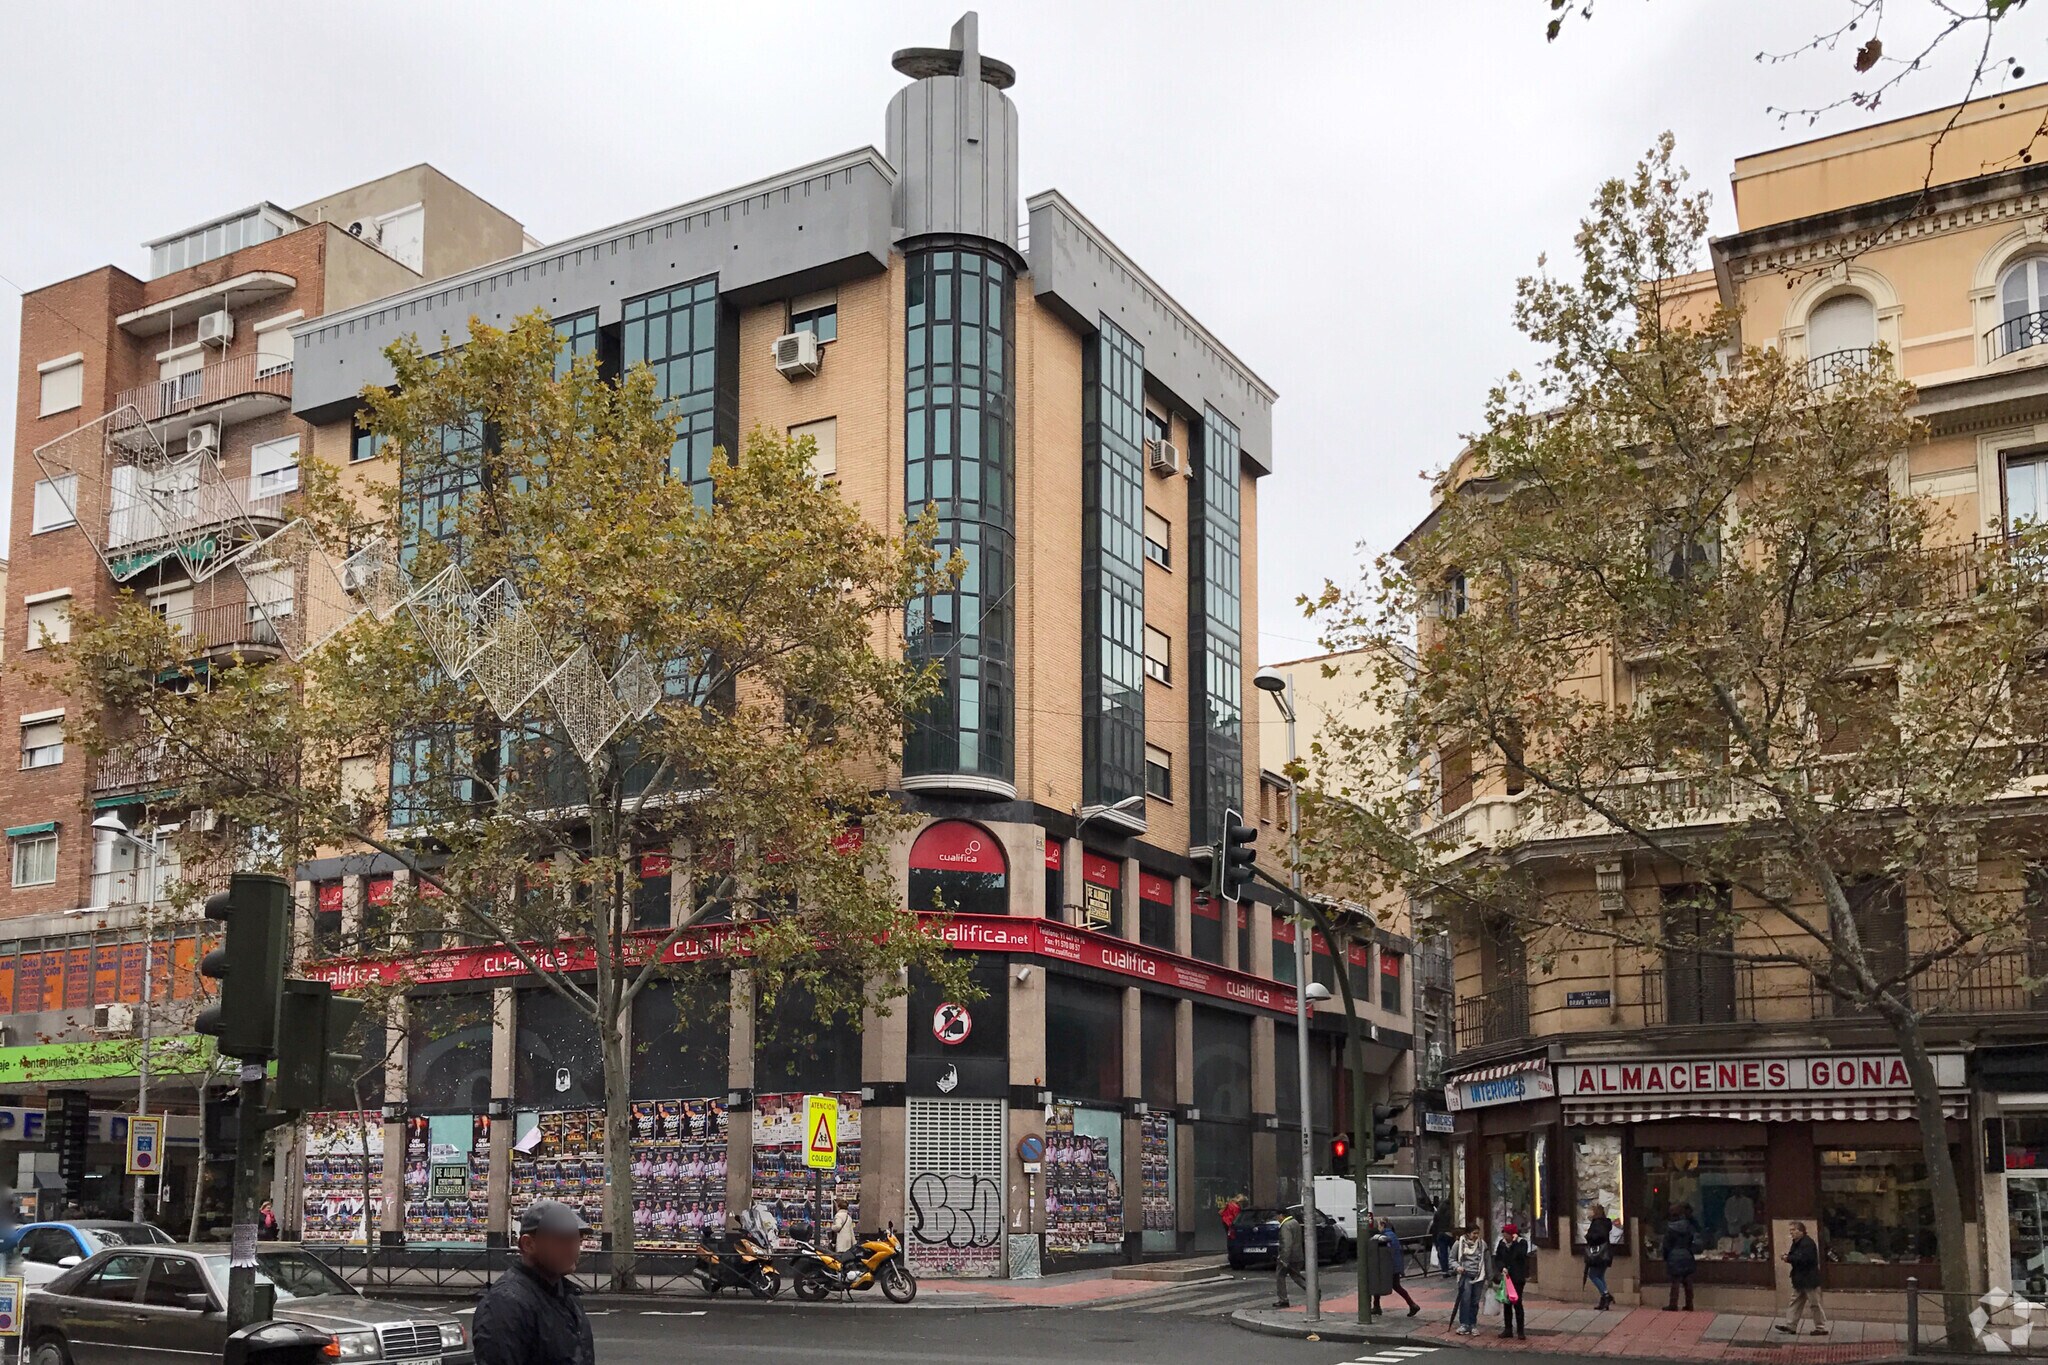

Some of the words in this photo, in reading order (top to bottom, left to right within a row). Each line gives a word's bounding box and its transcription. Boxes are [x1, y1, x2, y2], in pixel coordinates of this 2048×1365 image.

[940, 853, 977, 863] cualifica
[1102, 949, 1156, 976] cualifica
[1226, 981, 1270, 1004] cualifica
[1578, 1063, 1787, 1093] ALMACENES
[1811, 1058, 1909, 1087] GONA
[1470, 1077, 1526, 1103] INTERIORES
[811, 1154, 833, 1163] COLEGIO
[436, 1168, 443, 1178] SE
[443, 1167, 466, 1179] ALQUILA
